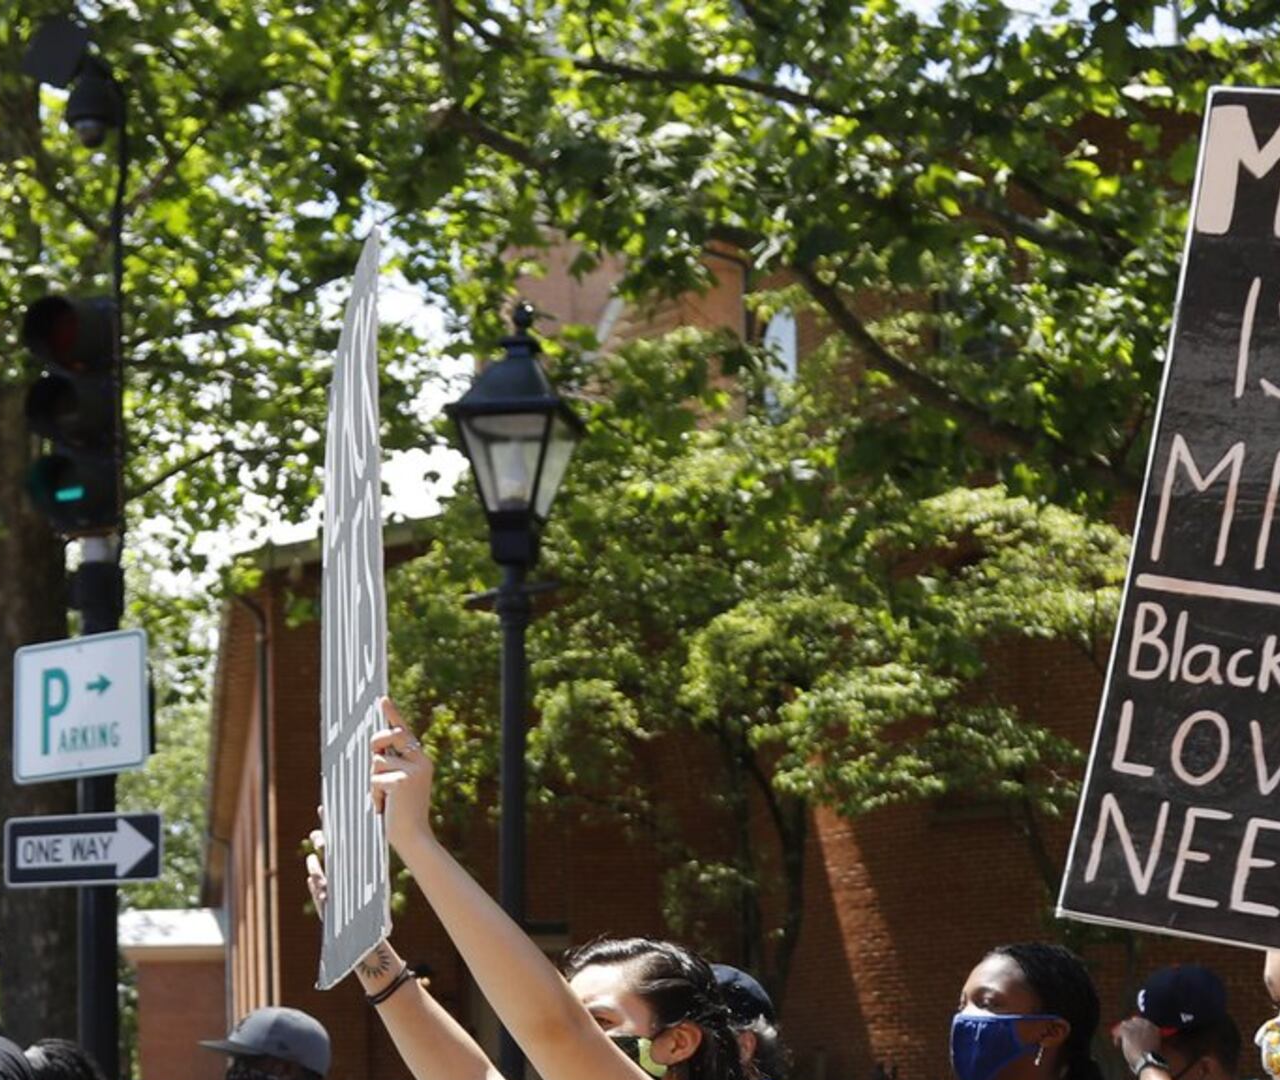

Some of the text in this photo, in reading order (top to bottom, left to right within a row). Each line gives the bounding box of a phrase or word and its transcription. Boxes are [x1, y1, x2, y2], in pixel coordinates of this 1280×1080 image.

[325, 481, 377, 746] LIVES
[22, 836, 113, 864] ONE WAY
